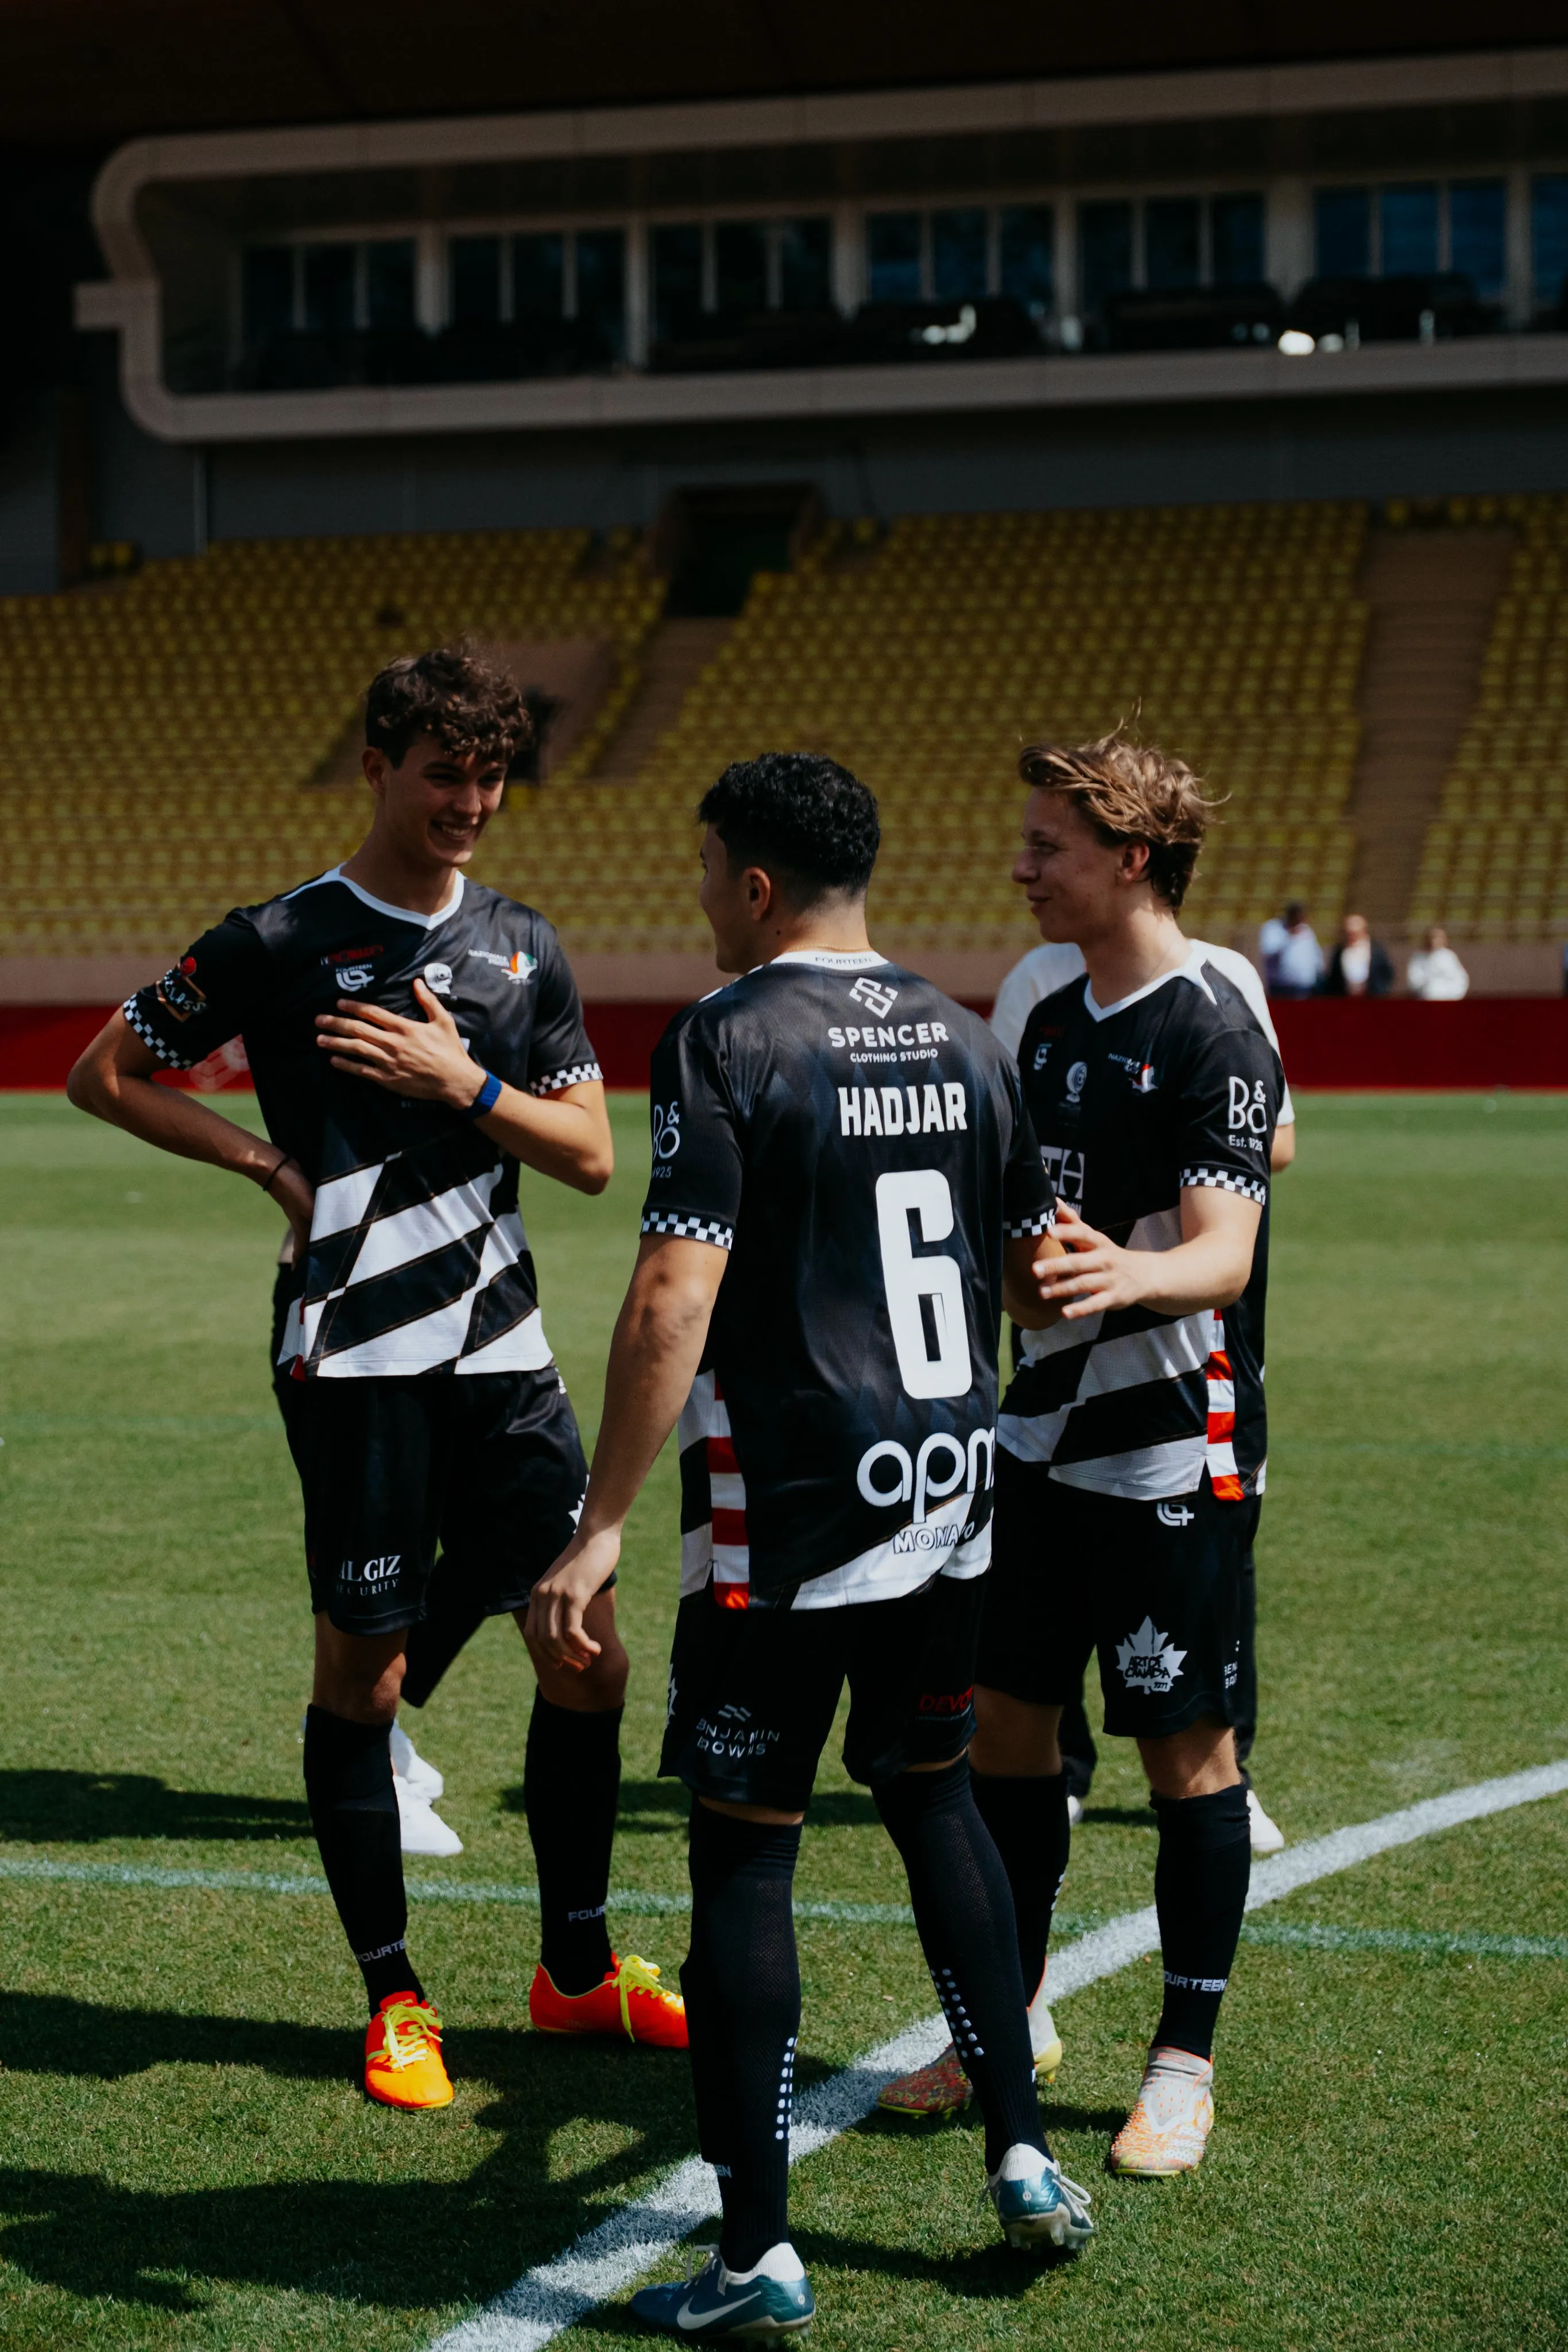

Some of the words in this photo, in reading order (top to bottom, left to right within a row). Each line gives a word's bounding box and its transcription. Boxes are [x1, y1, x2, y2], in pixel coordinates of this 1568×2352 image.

[828, 1022, 949, 1048] SPENCER
[850, 1052, 897, 1063] CLOTHING
[900, 1048, 938, 1062] STUDIO
[838, 1082, 968, 1136] HADJAR
[875, 1169, 973, 1400] 6
[893, 1521, 975, 1554] MONAO
[335, 1578, 399, 1596] ECURITY
